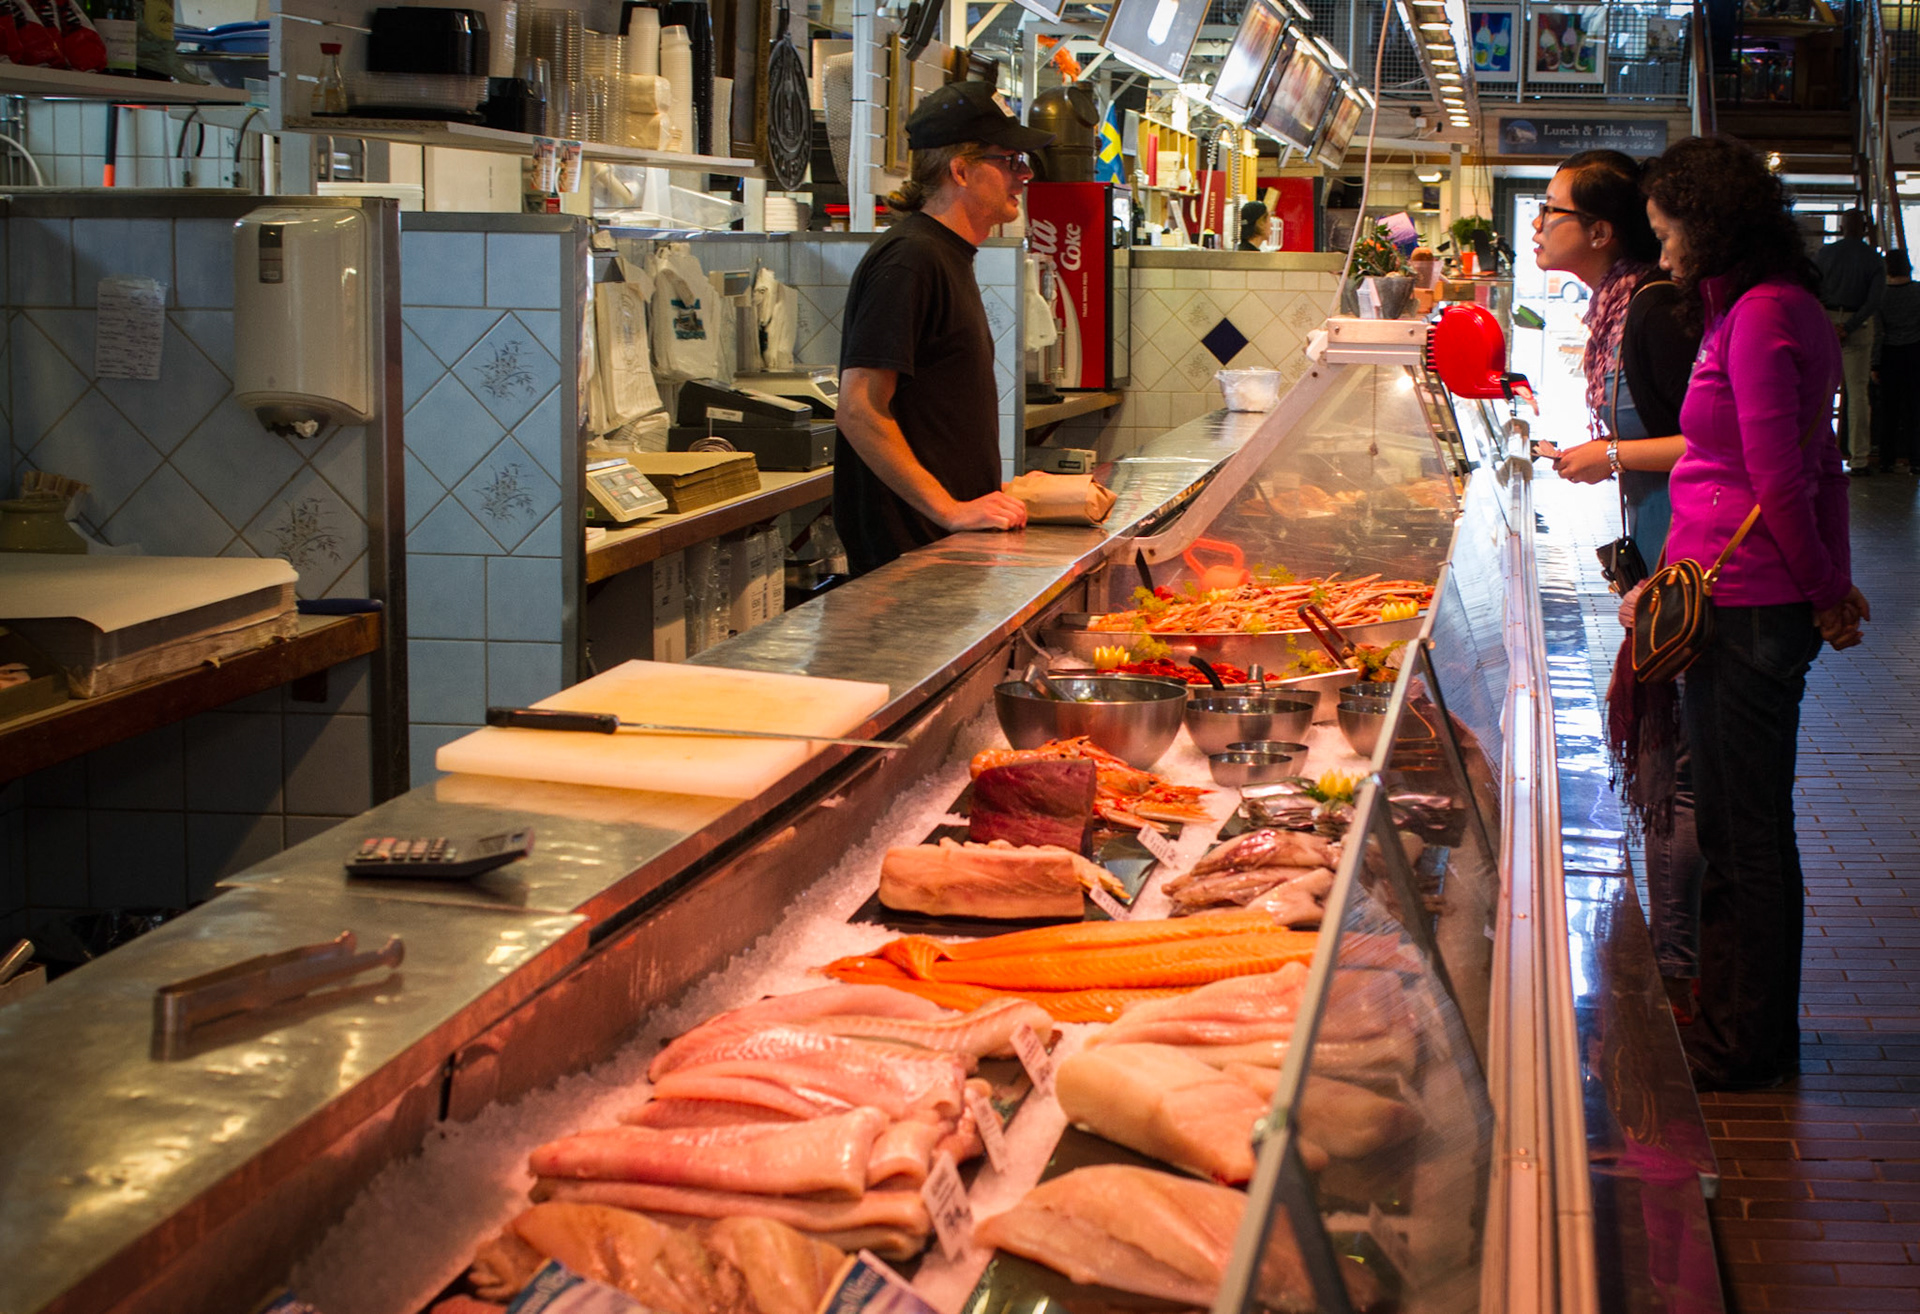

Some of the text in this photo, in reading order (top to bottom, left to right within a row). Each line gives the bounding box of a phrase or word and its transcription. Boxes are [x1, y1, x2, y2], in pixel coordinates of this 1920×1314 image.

[1543, 124, 1658, 140] Lunch & Take Away
[1060, 223, 1081, 271] Coke
